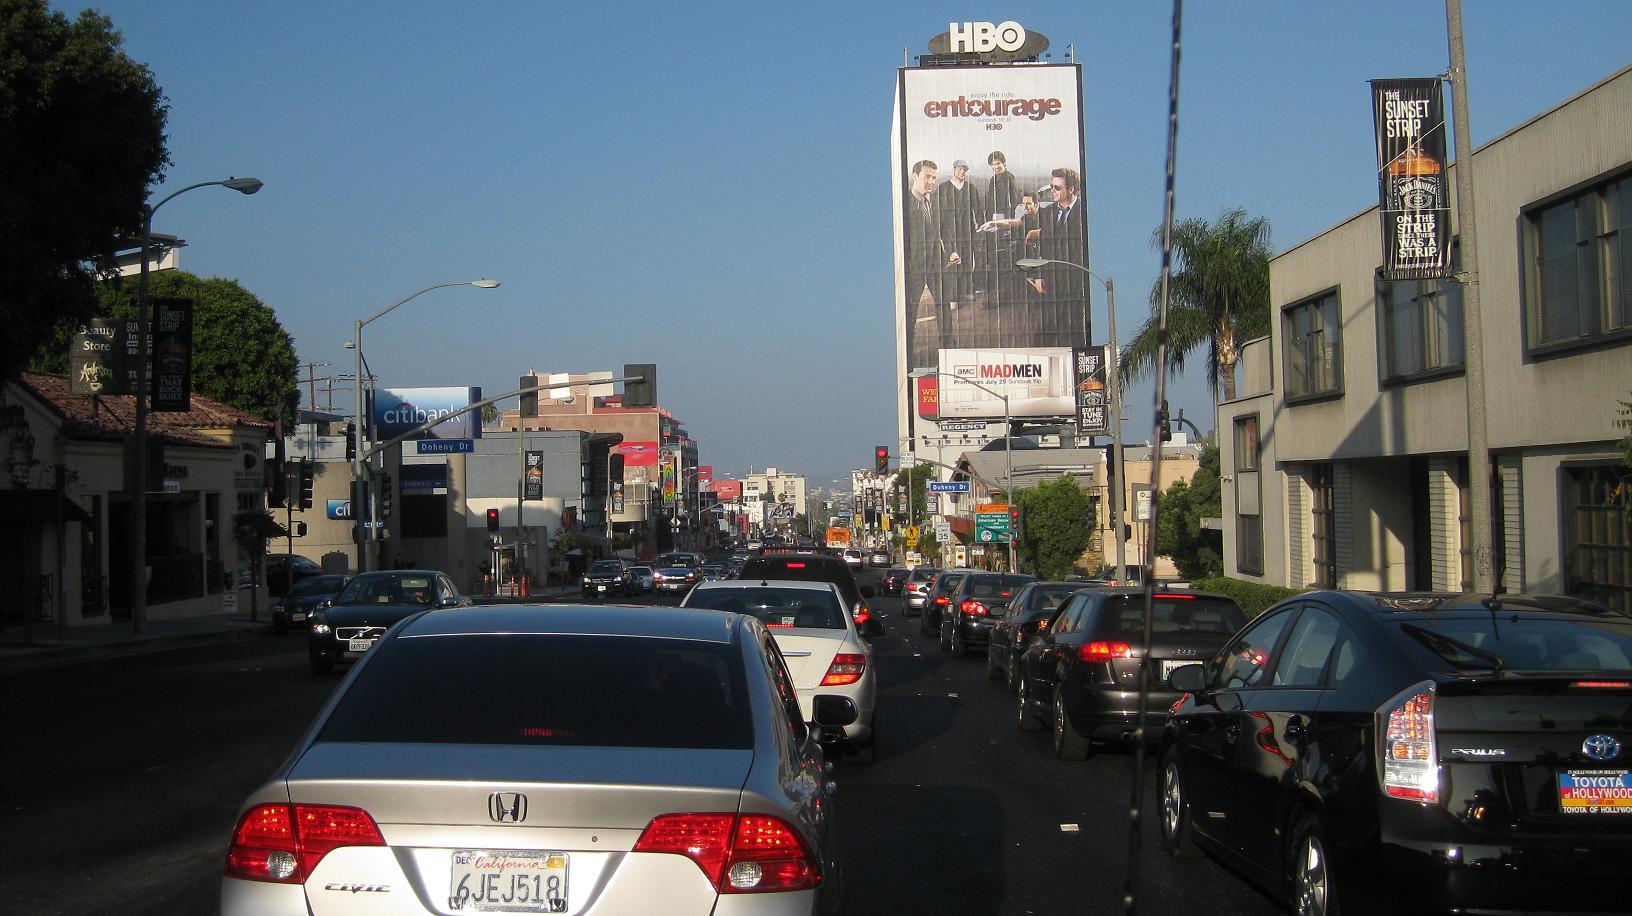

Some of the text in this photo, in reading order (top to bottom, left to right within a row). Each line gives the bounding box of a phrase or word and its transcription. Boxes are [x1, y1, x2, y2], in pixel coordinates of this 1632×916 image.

[950, 20, 1026, 53] HBO
[1385, 91, 1400, 100] THE
[923, 95, 1062, 121] entourage
[1385, 100, 1429, 119] SUNSET
[986, 123, 1003, 131] HBO
[1387, 119, 1421, 138] STRIP
[1398, 182, 1414, 196] JACK
[1396, 214, 1435, 223] ON THE
[1397, 223, 1436, 233] STRIP
[1398, 238, 1437, 247] WAS A
[1398, 247, 1438, 258] STRIP.
[160, 311, 185, 322] SUNSET
[80, 325, 116, 339] Beauty
[160, 322, 180, 332] STRIP
[83, 340, 111, 351] Store
[1078, 356, 1099, 365] SUNSET
[1079, 365, 1095, 373] STRIP
[384, 404, 464, 424] citibank
[941, 423, 985, 431] REGENCY
[421, 443, 469, 452] Doheny Dr
[1451, 748, 1506, 756] PRIUS
[1571, 776, 1625, 788] TOYOTA
[1564, 791, 1571, 799] of
[1562, 806, 1587, 814] TOYOTA
[474, 856, 540, 873] California
[324, 882, 392, 894] CIVIC
[456, 873, 560, 903] 6JEJ518
